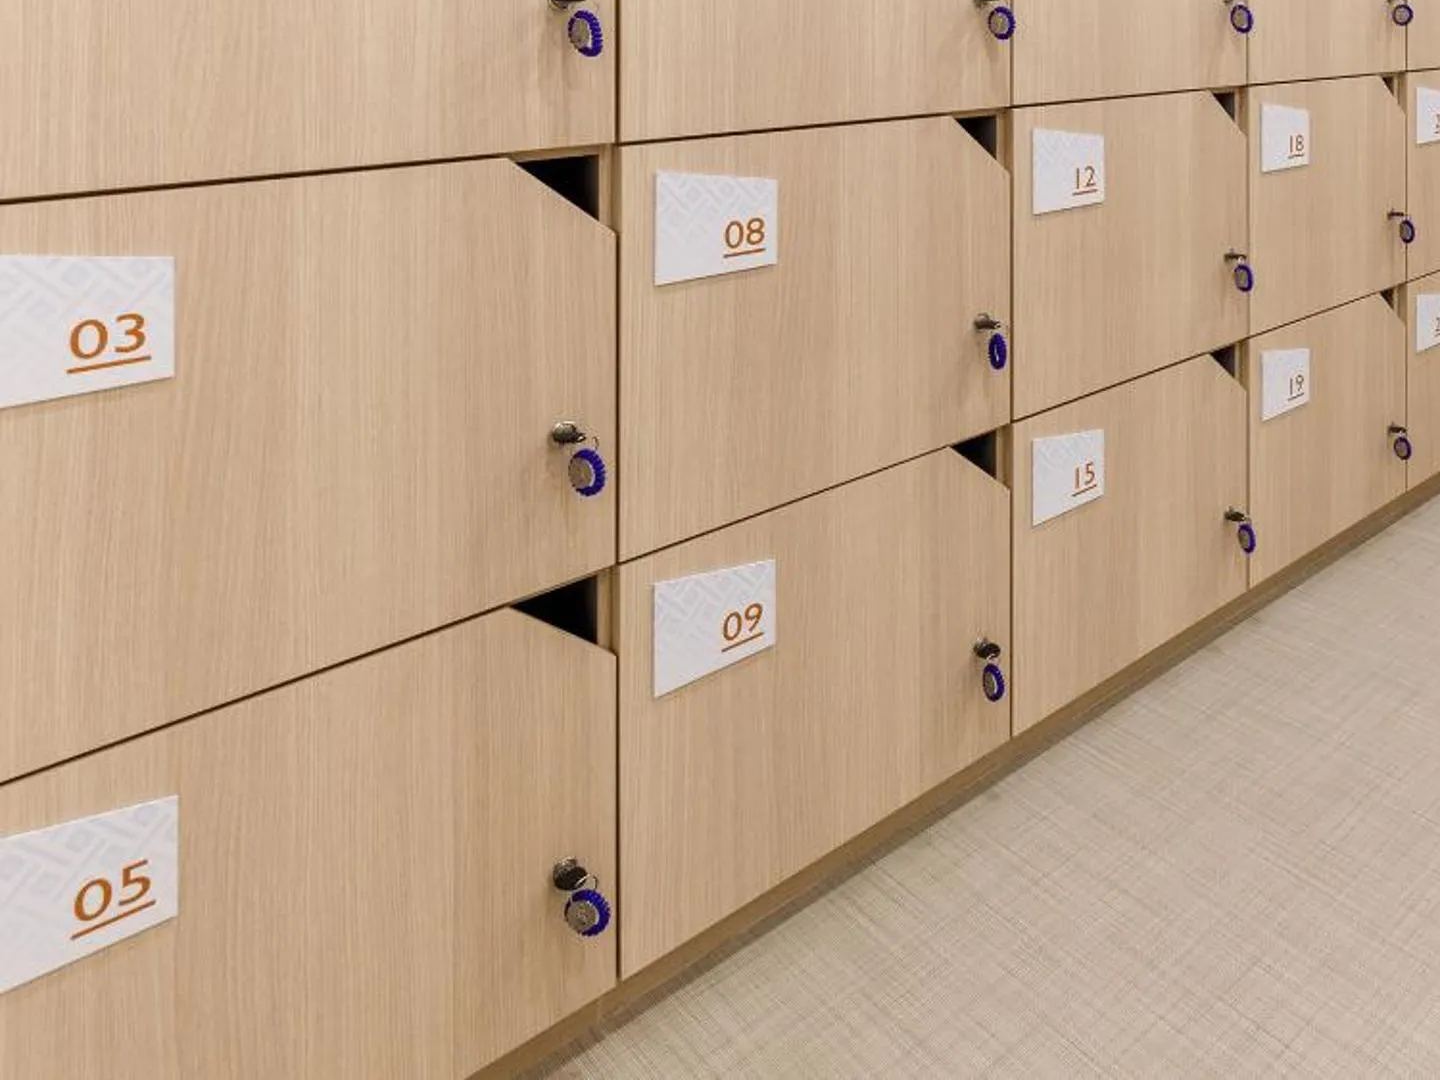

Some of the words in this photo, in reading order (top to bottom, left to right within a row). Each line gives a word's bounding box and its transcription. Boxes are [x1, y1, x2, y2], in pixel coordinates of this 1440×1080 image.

[1289, 135, 1304, 153] 18
[1076, 166, 1096, 189] 12
[725, 218, 764, 249] 08
[71, 314, 145, 359] 03
[1289, 375, 1304, 394] 19
[1075, 461, 1096, 488] 15
[724, 604, 762, 640] 09
[75, 861, 150, 921] 05
